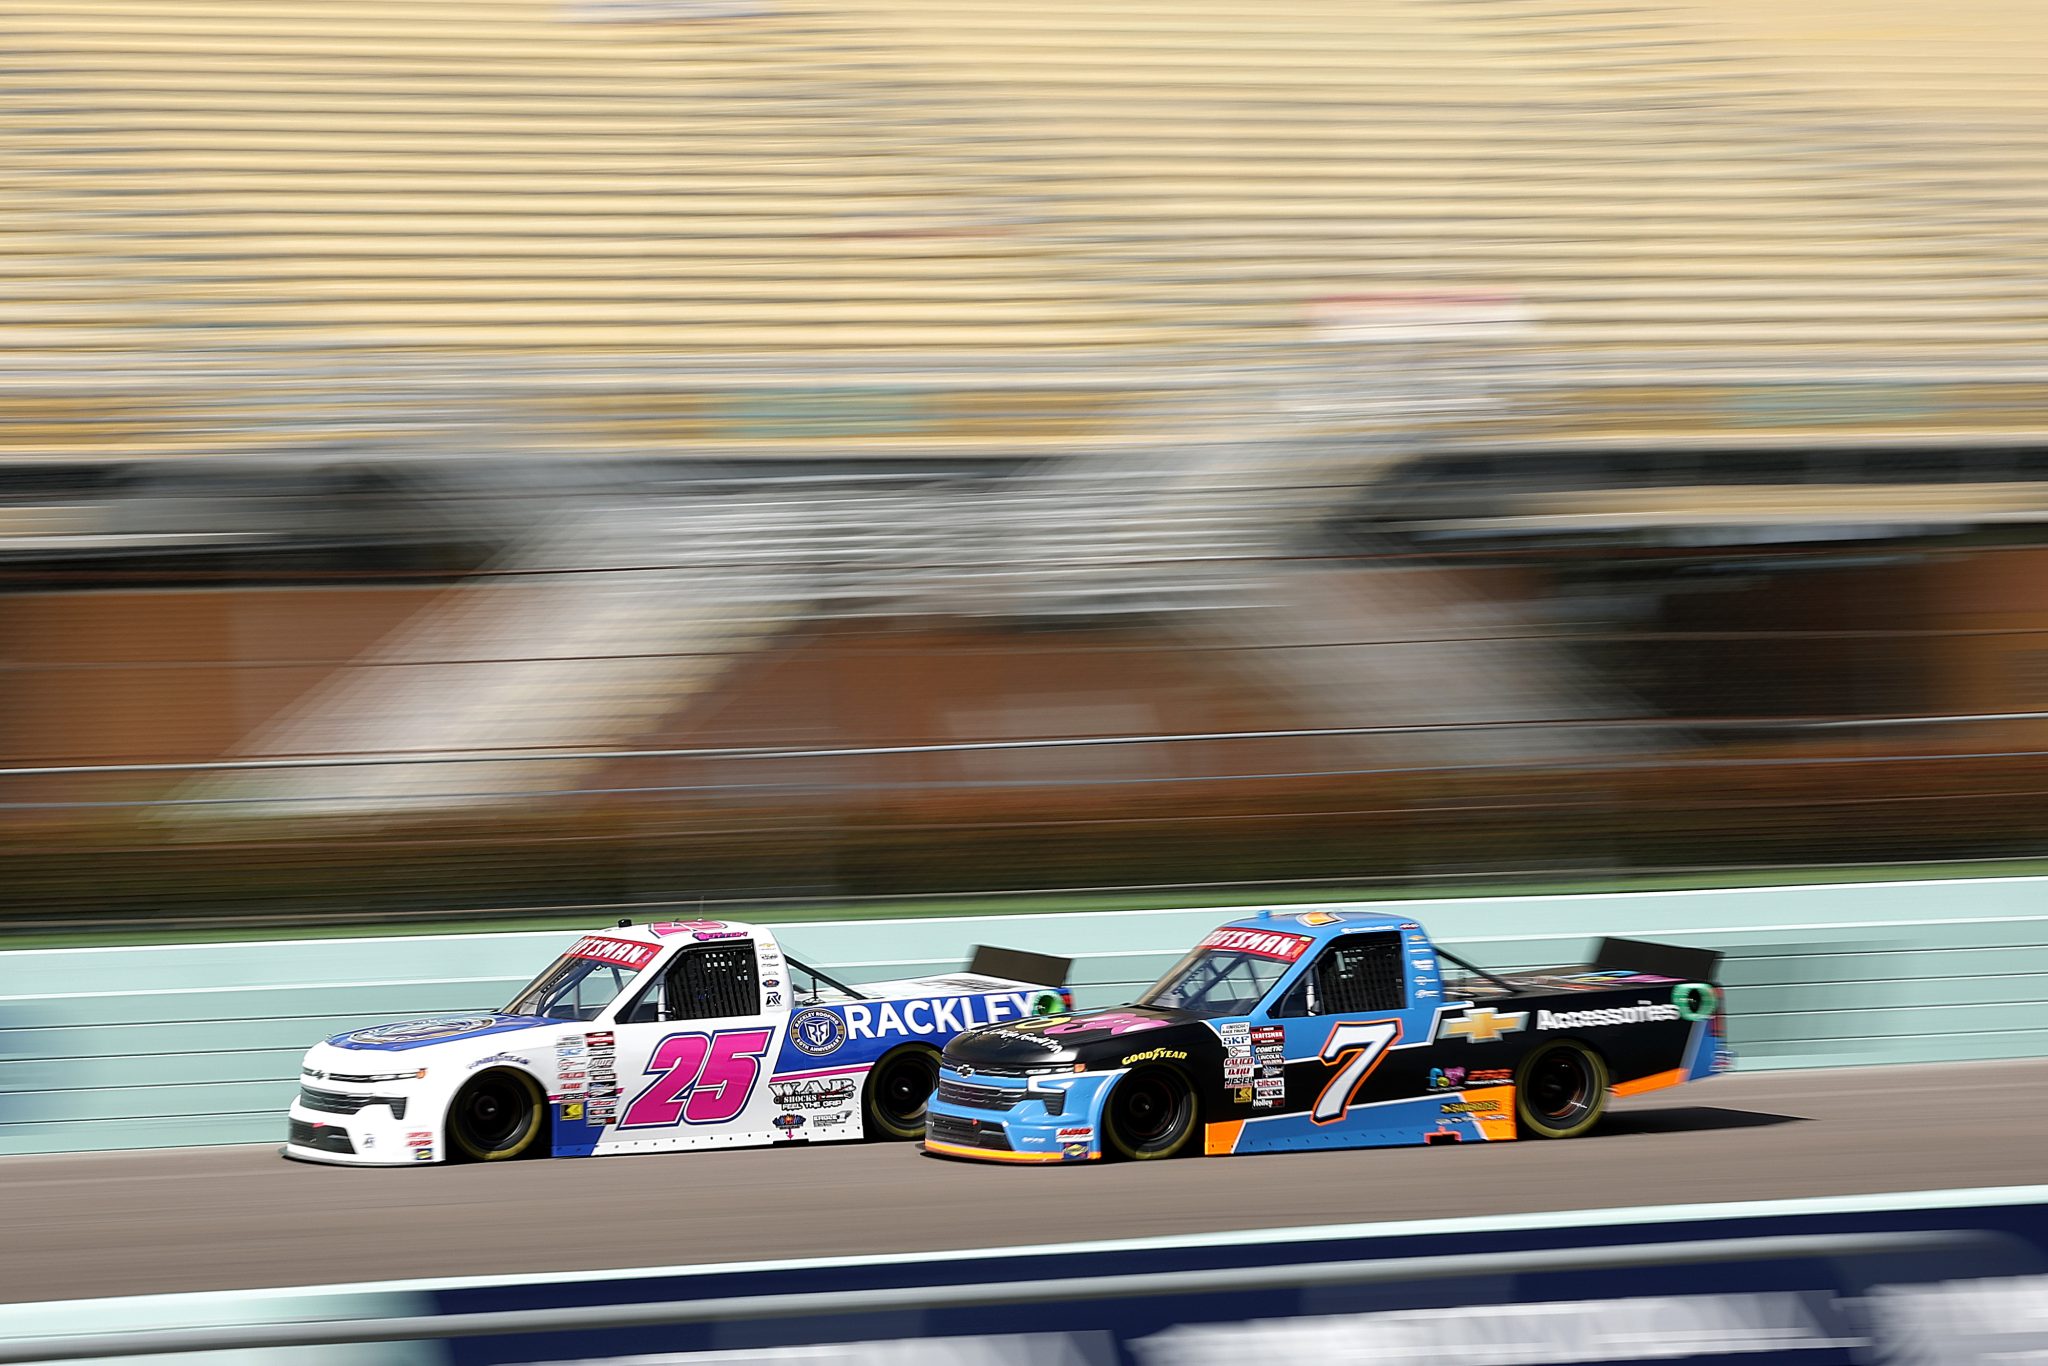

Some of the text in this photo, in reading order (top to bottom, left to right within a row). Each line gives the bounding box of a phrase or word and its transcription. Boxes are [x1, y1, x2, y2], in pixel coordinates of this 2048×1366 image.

[843, 991, 1036, 1040] RACKLEY
[1223, 1036, 1249, 1045] SKF
[1121, 1048, 1188, 1065] GOODYEAR
[1225, 1057, 1254, 1066] CALICO
[1310, 1018, 1403, 1127] 7
[615, 1026, 776, 1131] 25
[1226, 1077, 1253, 1085] JESEL
[783, 1094, 817, 1104] SHOCKS
[1253, 1099, 1273, 1108] Holley
